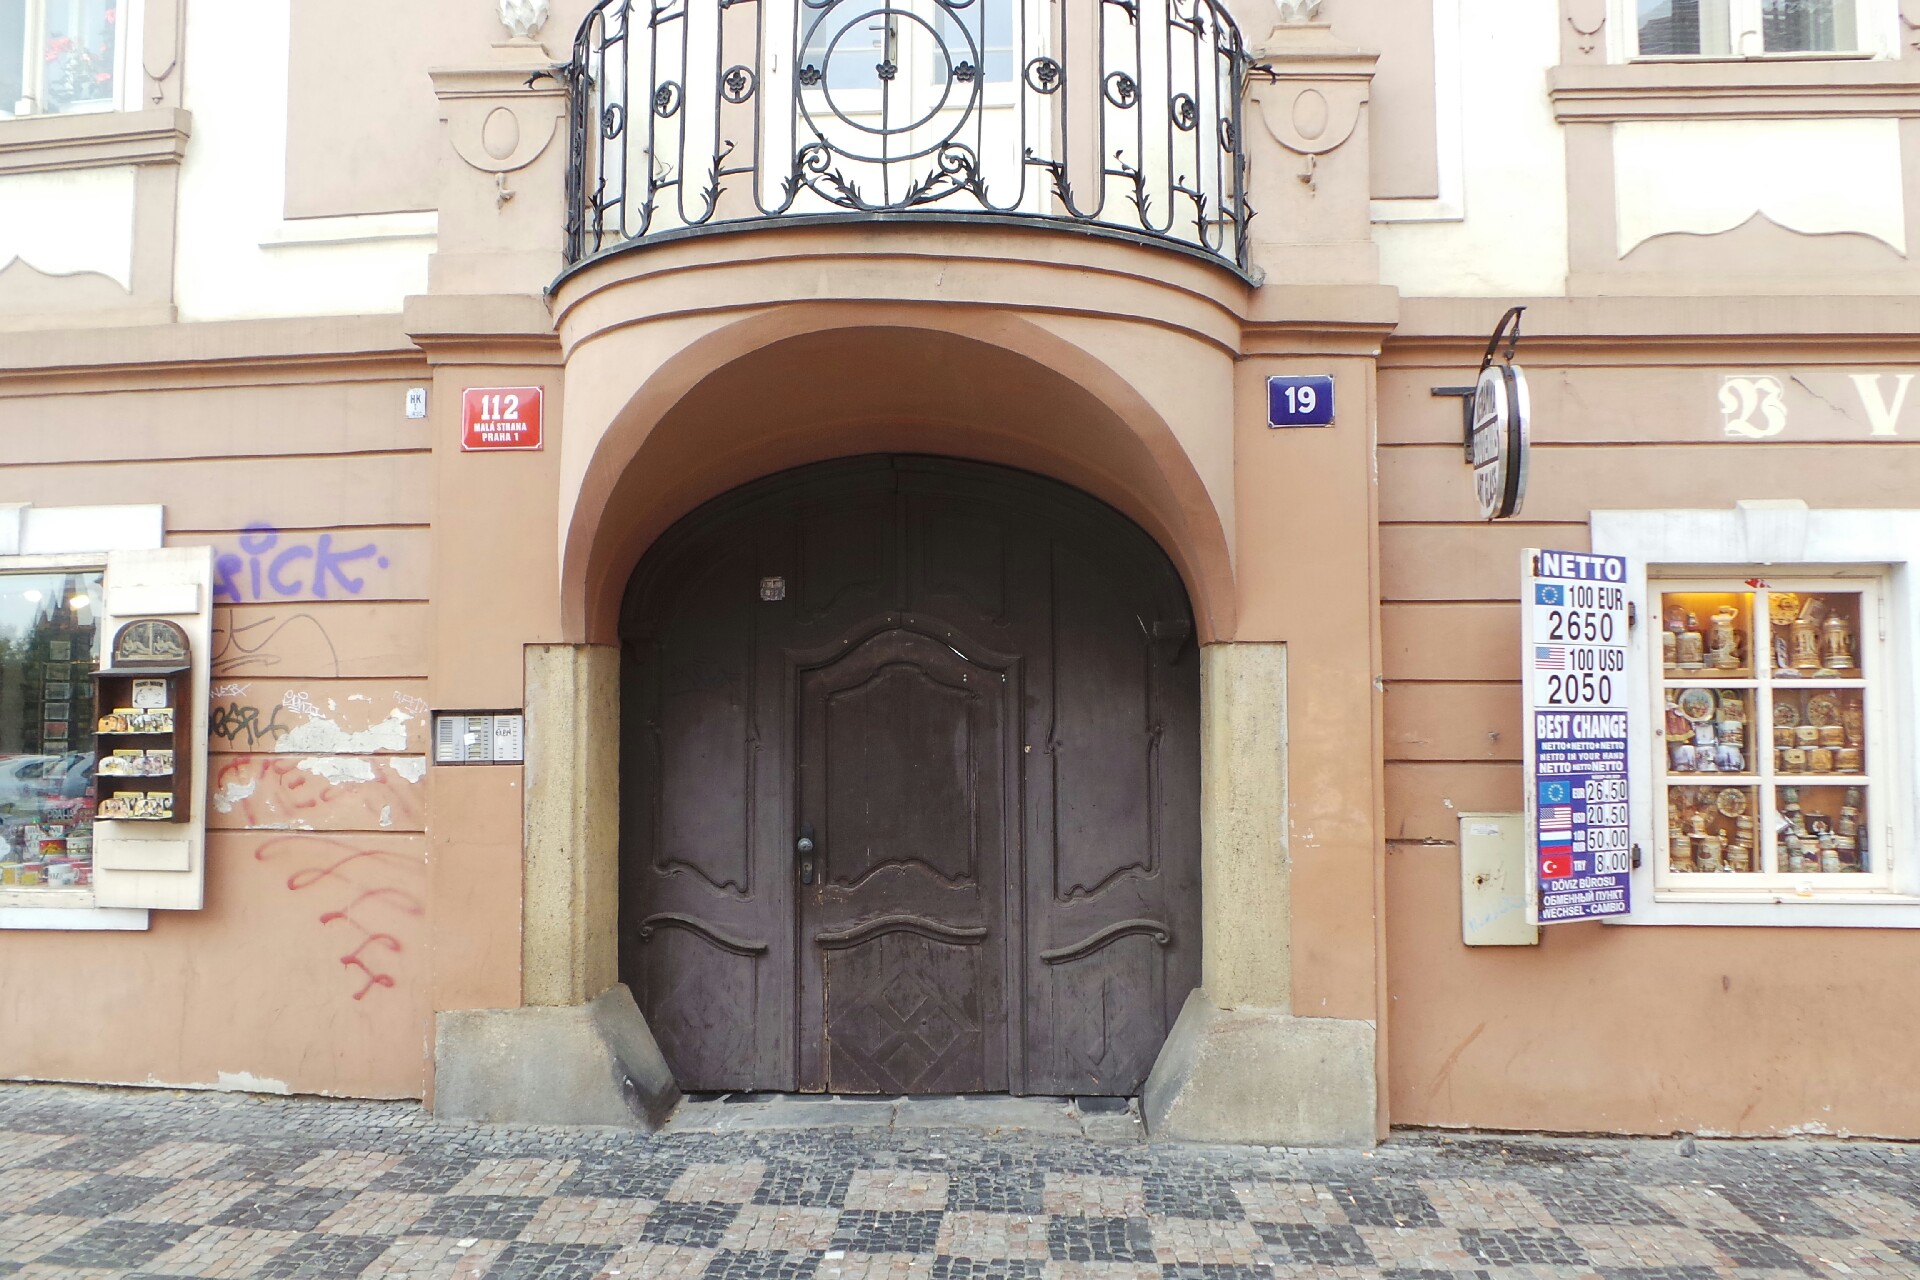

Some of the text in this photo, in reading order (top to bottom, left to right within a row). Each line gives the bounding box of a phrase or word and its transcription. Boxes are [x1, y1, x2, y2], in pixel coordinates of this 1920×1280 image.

[410, 394, 421, 404] HK
[481, 394, 519, 420] 112
[1284, 386, 1316, 414] 19
[1848, 374, 1915, 435] V
[474, 421, 528, 432] MALÁ STRANA
[482, 432, 519, 441] PRAHA 1
[1543, 553, 1621, 581] NETTO
[1569, 585, 1623, 610] 100 EUR
[1549, 610, 1613, 642] 2650
[1569, 649, 1623, 671] 100 USD
[1548, 673, 1611, 704] 2050
[1537, 715, 1626, 738] BEST CHANGE
[1539, 762, 1571, 773] NETTO
[1591, 761, 1623, 771] NETTO
[1540, 753, 1565, 761] NETTO
[1602, 752, 1624, 760] HAND
[1543, 889, 1624, 906] ОБМЕННЫЙ ПУНКТ
[1542, 902, 1625, 919] WECHSEL CAMBIO
